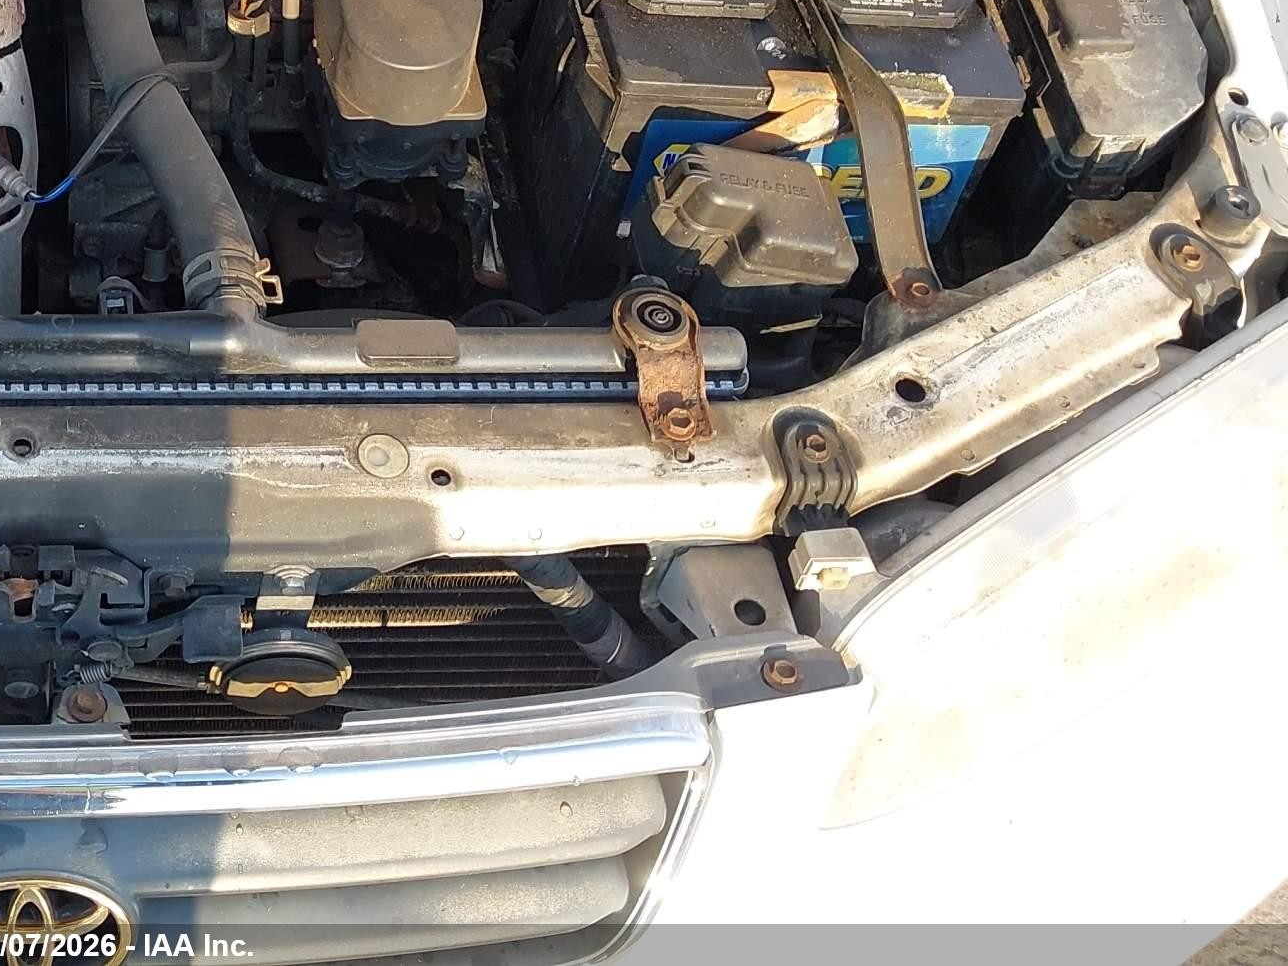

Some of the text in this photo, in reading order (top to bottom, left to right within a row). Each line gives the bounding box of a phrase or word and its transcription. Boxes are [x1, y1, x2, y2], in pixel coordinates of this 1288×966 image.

[1132, 14, 1168, 26] FUSE
[719, 172, 759, 188] RELAY
[775, 182, 810, 198] FUSE
